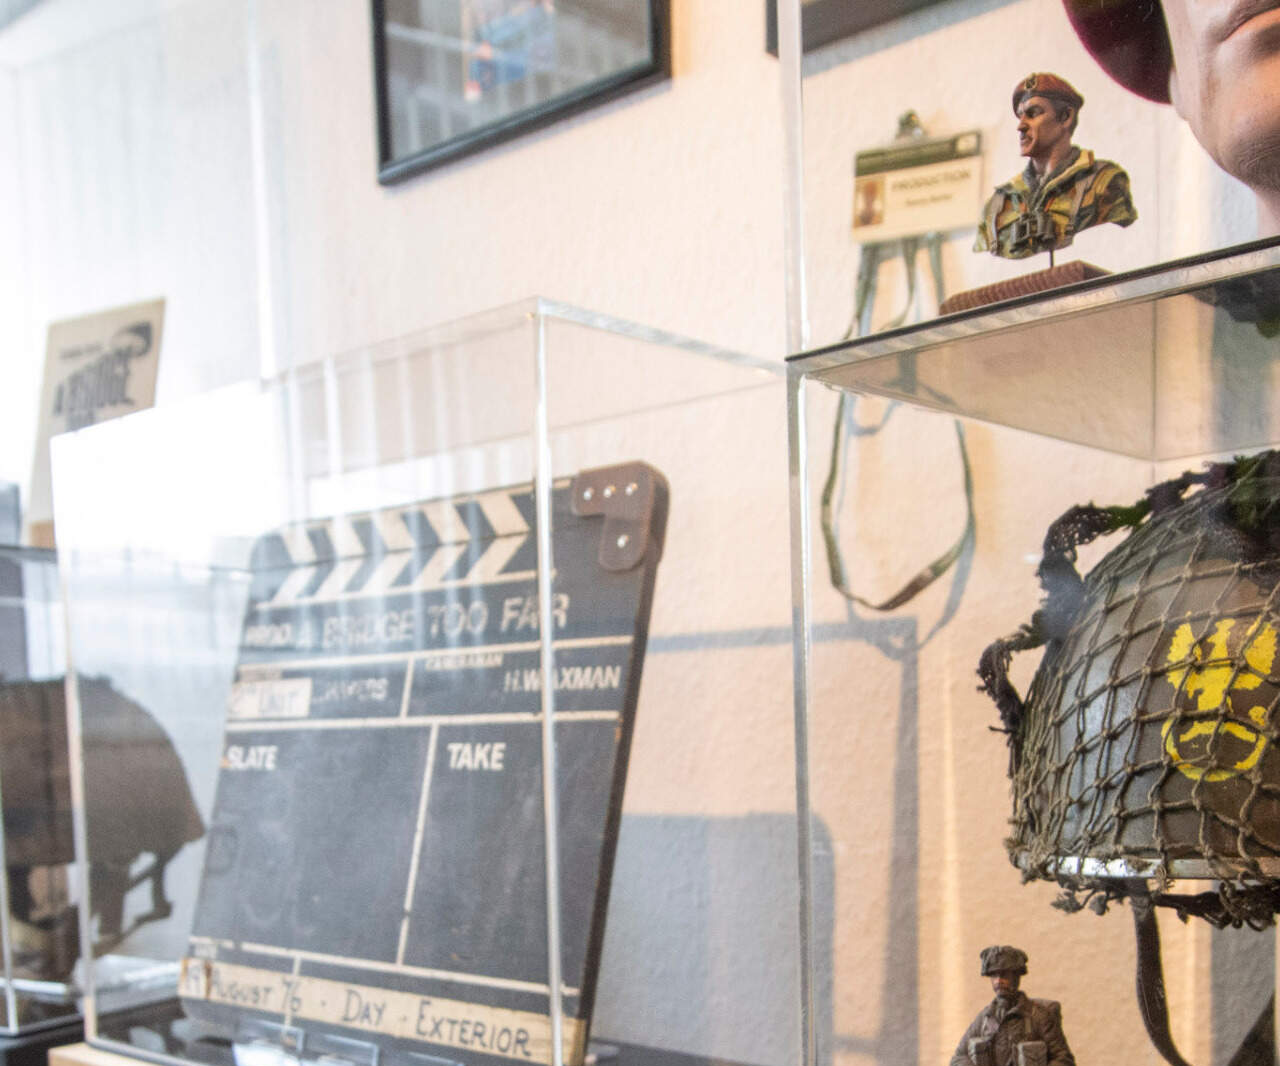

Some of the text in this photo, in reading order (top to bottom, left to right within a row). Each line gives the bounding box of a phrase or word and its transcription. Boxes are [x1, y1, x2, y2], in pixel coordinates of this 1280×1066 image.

[323, 608, 415, 649] BRIDGE
[427, 600, 489, 639] TOO
[500, 592, 570, 633] FAR
[227, 745, 278, 770] SLATE
[447, 742, 506, 771] TAKE
[341, 987, 387, 1027] DAY
[415, 999, 532, 1058] EXTERIOR
